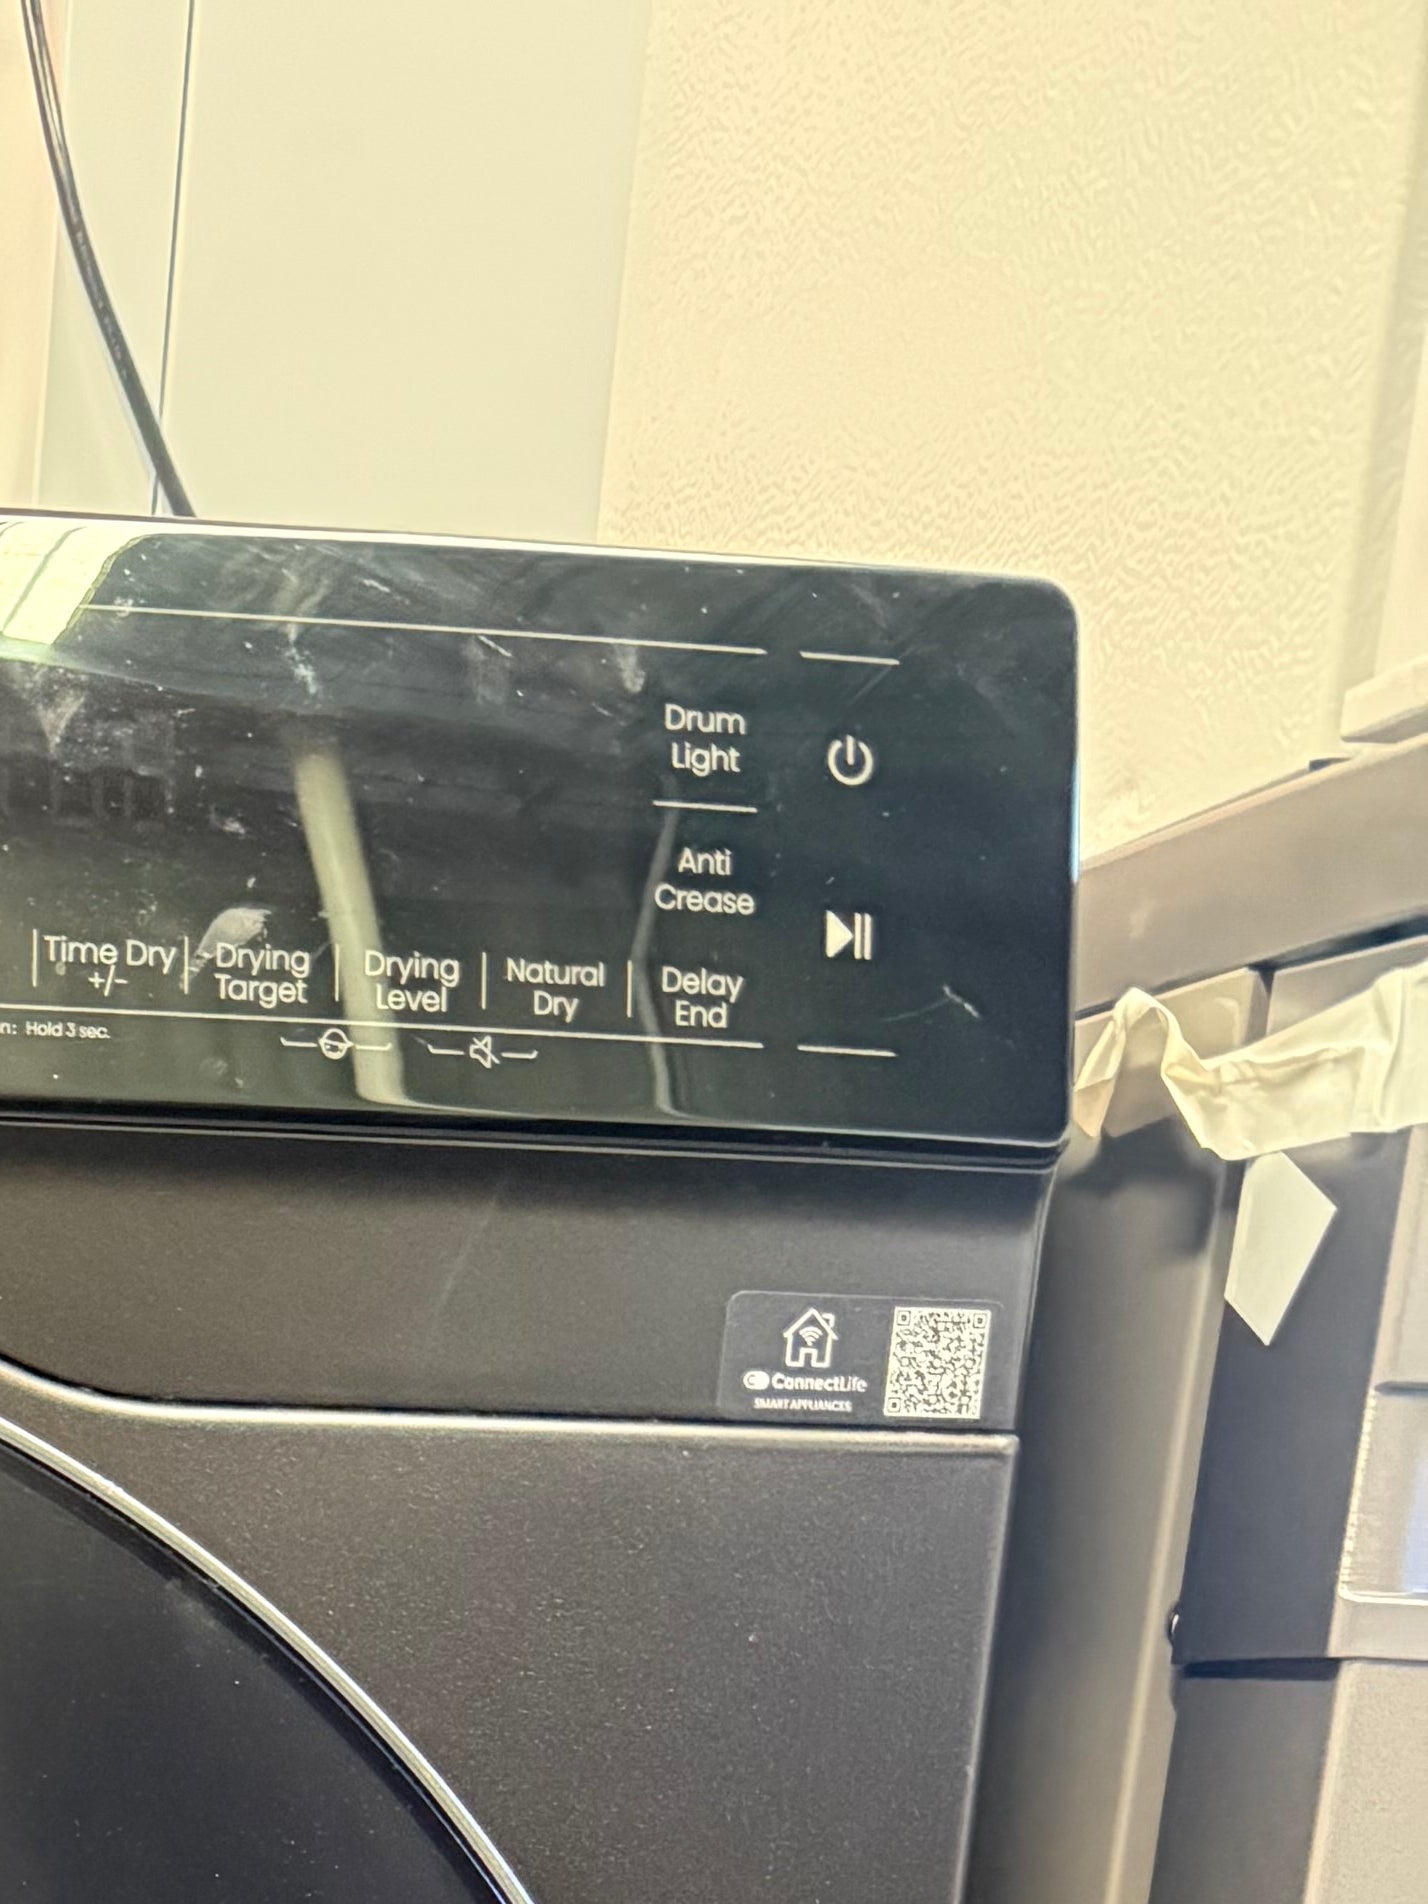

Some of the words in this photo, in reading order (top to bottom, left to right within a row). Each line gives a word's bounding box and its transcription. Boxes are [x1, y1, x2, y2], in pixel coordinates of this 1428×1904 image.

[664, 704, 746, 735] Drum
[671, 742, 740, 776] Light
[677, 847, 732, 876] Anti
[654, 883, 755, 915] Crease
[44, 933, 117, 965] Time
[126, 938, 177, 973] Dry
[216, 942, 310, 978] Drying
[365, 951, 460, 986] Drying
[507, 957, 605, 987] Natural
[661, 966, 743, 1004] Delay
[214, 974, 308, 1007] Target
[375, 985, 447, 1012] Level
[533, 990, 579, 1023] Dry
[674, 1001, 728, 1029] End
[771, 1373, 867, 1393] ConnectLife
